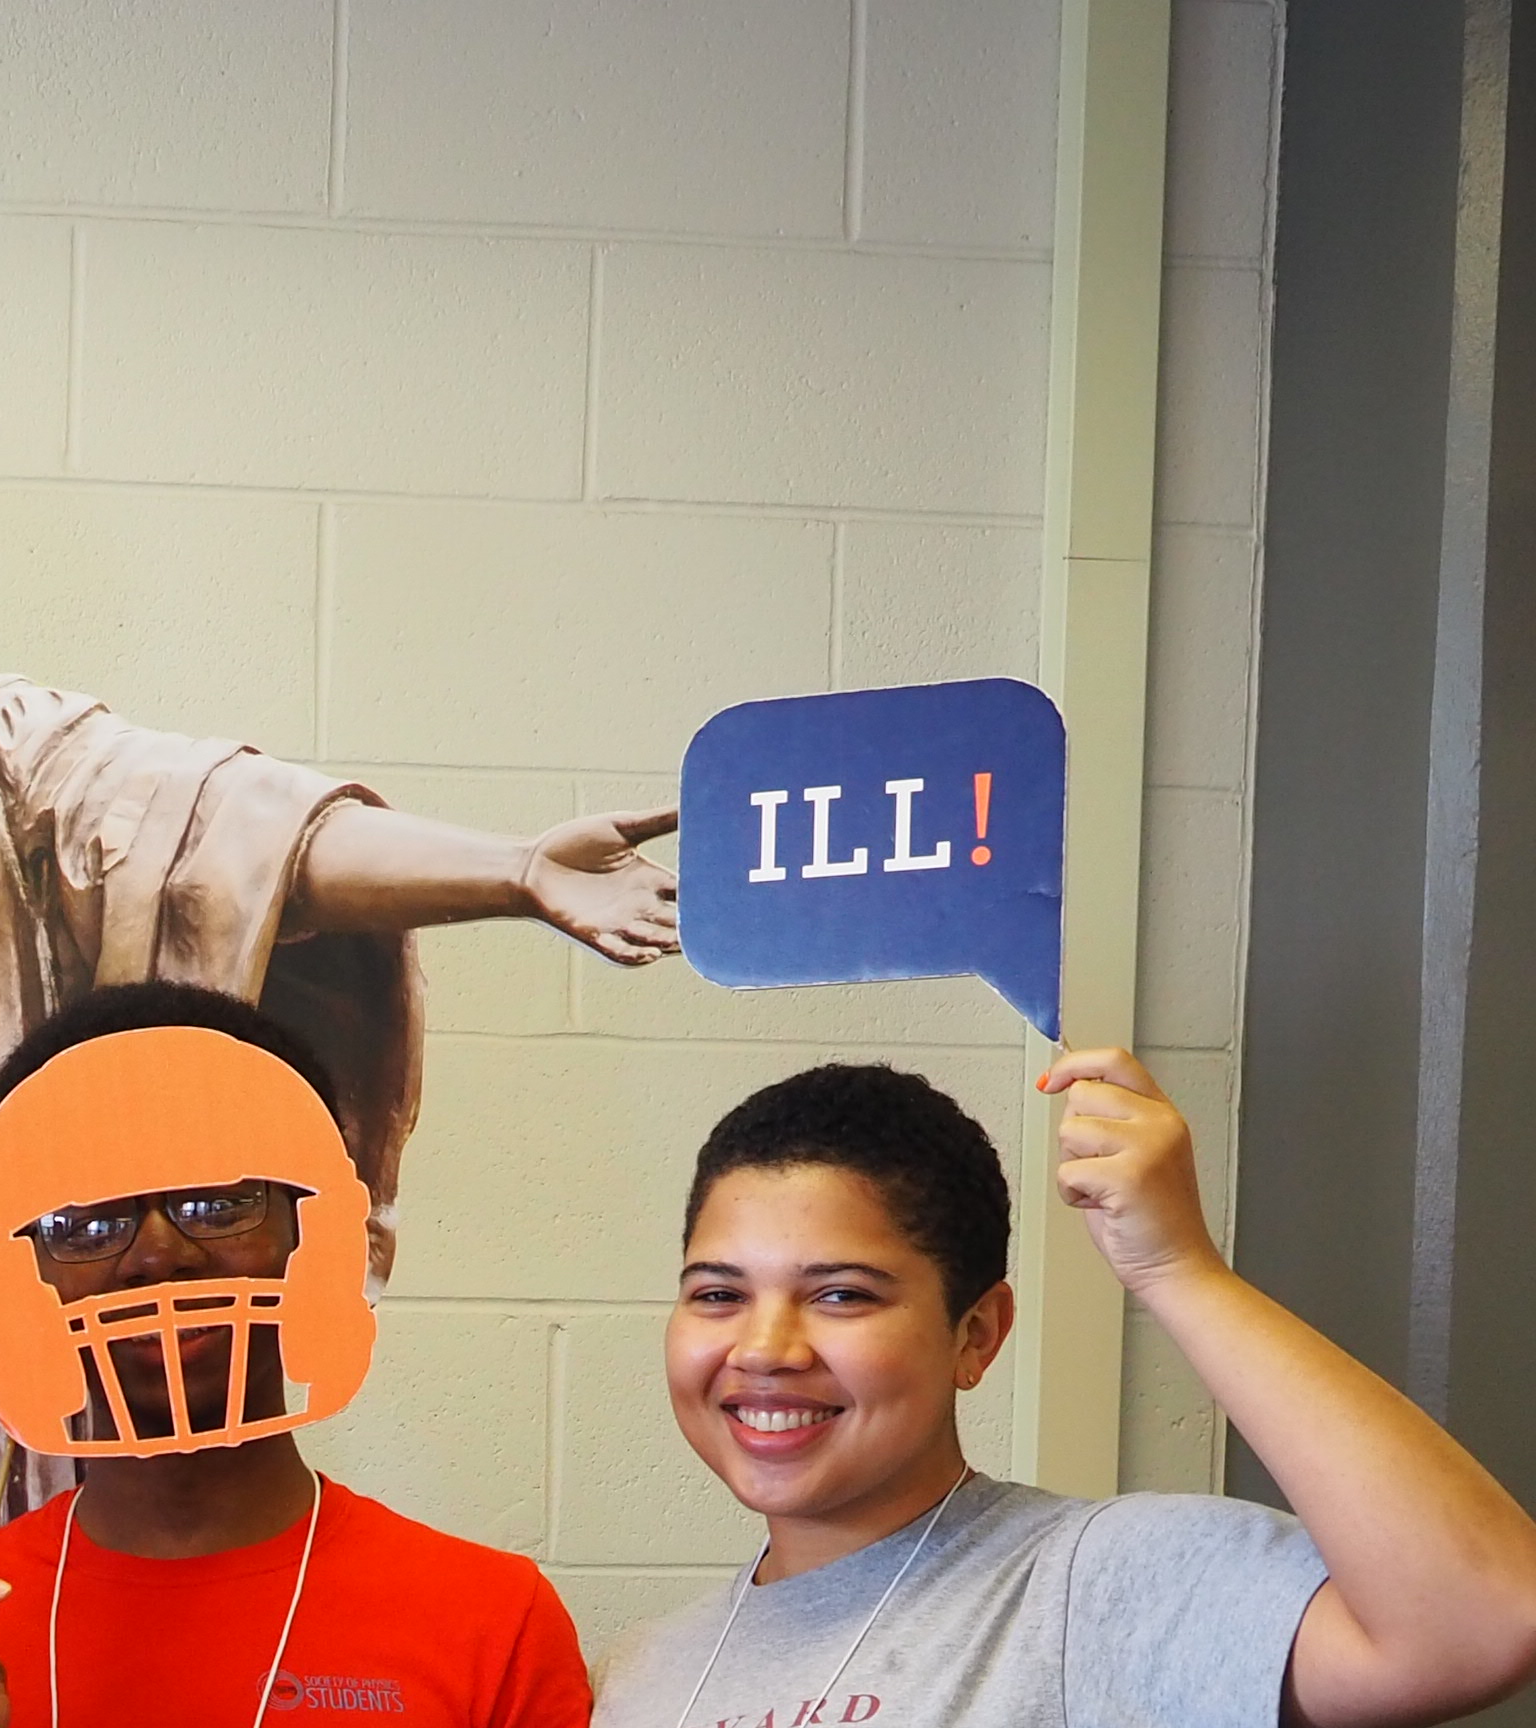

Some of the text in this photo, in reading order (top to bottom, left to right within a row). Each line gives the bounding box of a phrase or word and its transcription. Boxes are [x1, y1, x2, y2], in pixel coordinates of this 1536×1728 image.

[748, 772, 992, 883] ILL!
[304, 1675, 402, 1692] SOCIETY OF PHYSICS
[305, 1687, 405, 1713] STUDENTS
